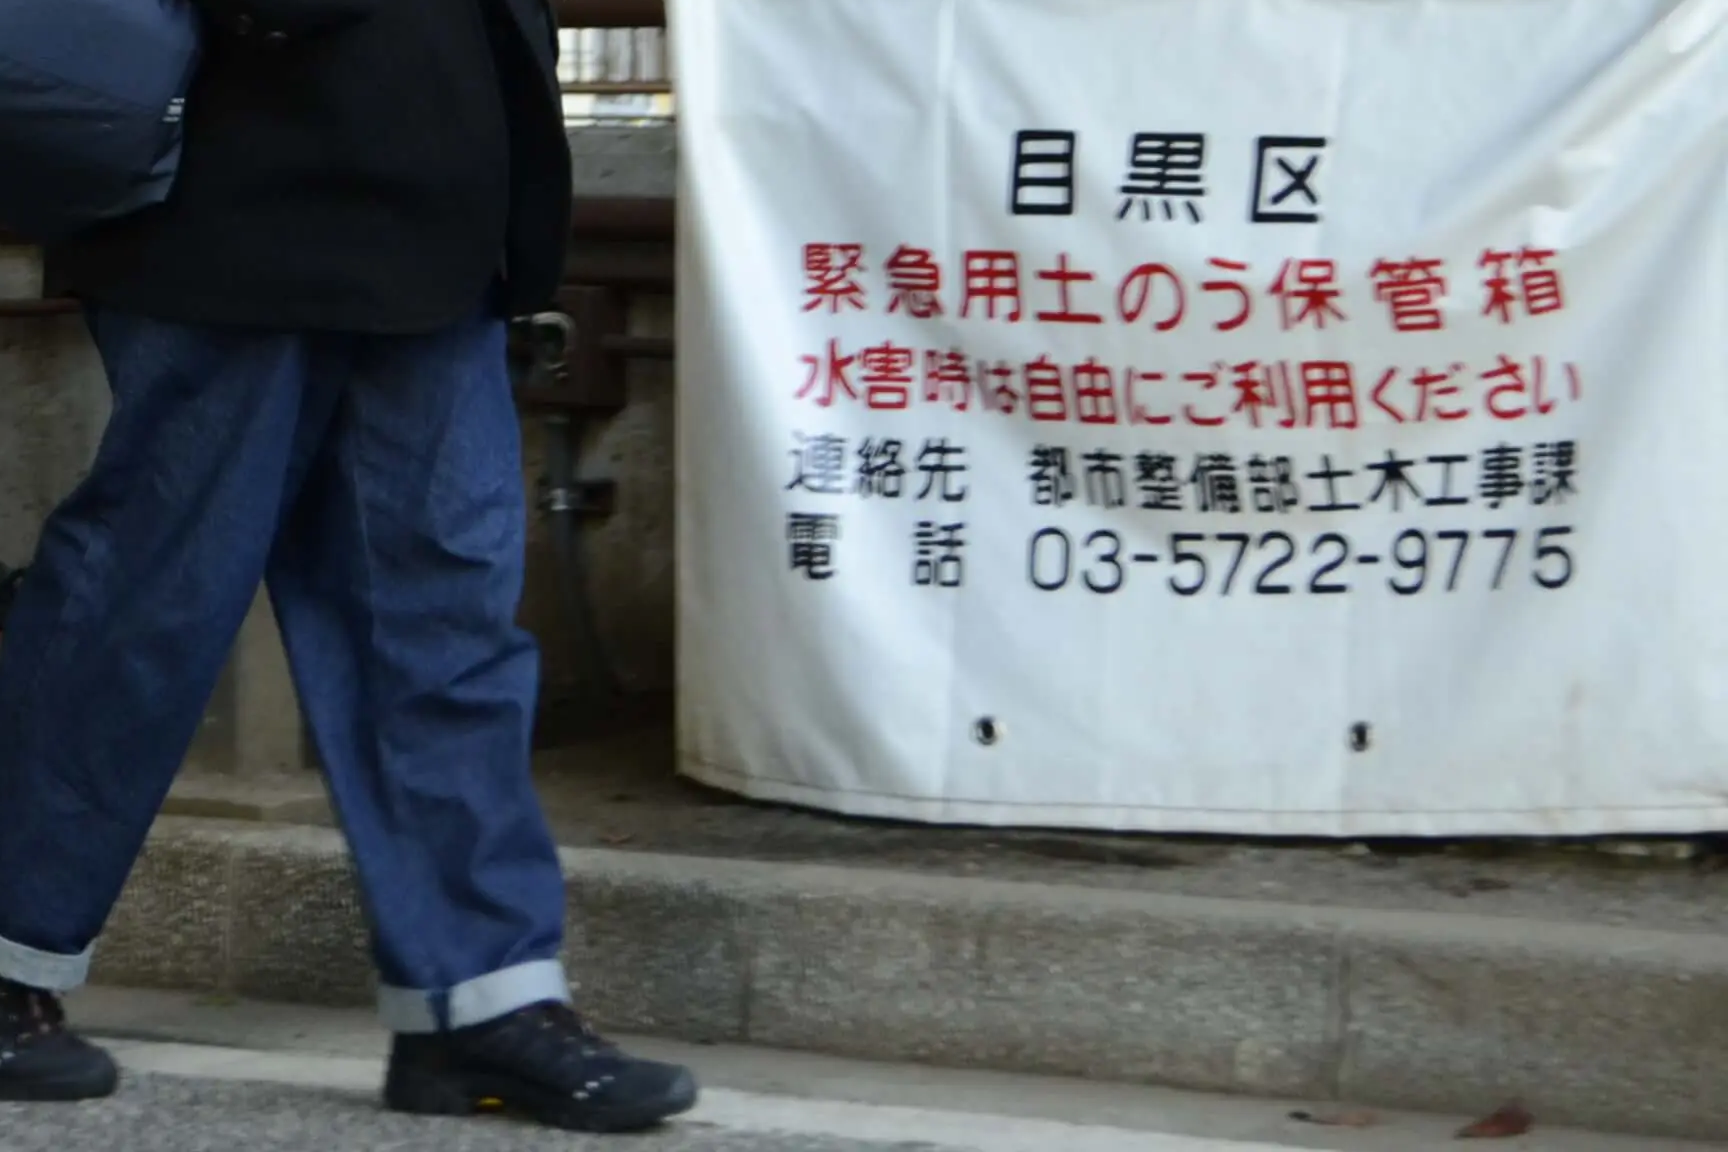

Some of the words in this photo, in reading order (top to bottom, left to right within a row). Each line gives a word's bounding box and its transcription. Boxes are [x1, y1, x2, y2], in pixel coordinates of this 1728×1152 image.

[1007, 127, 1329, 224] 目黒区
[800, 242, 1565, 333] 緊急用土のう保管箱
[794, 338, 1581, 430] 水害時は自由にご利用ください
[785, 431, 969, 503] 連絡先
[1027, 439, 1579, 514] 都市整備部土木工事課
[1027, 525, 1576, 598] 03-5722-9775
